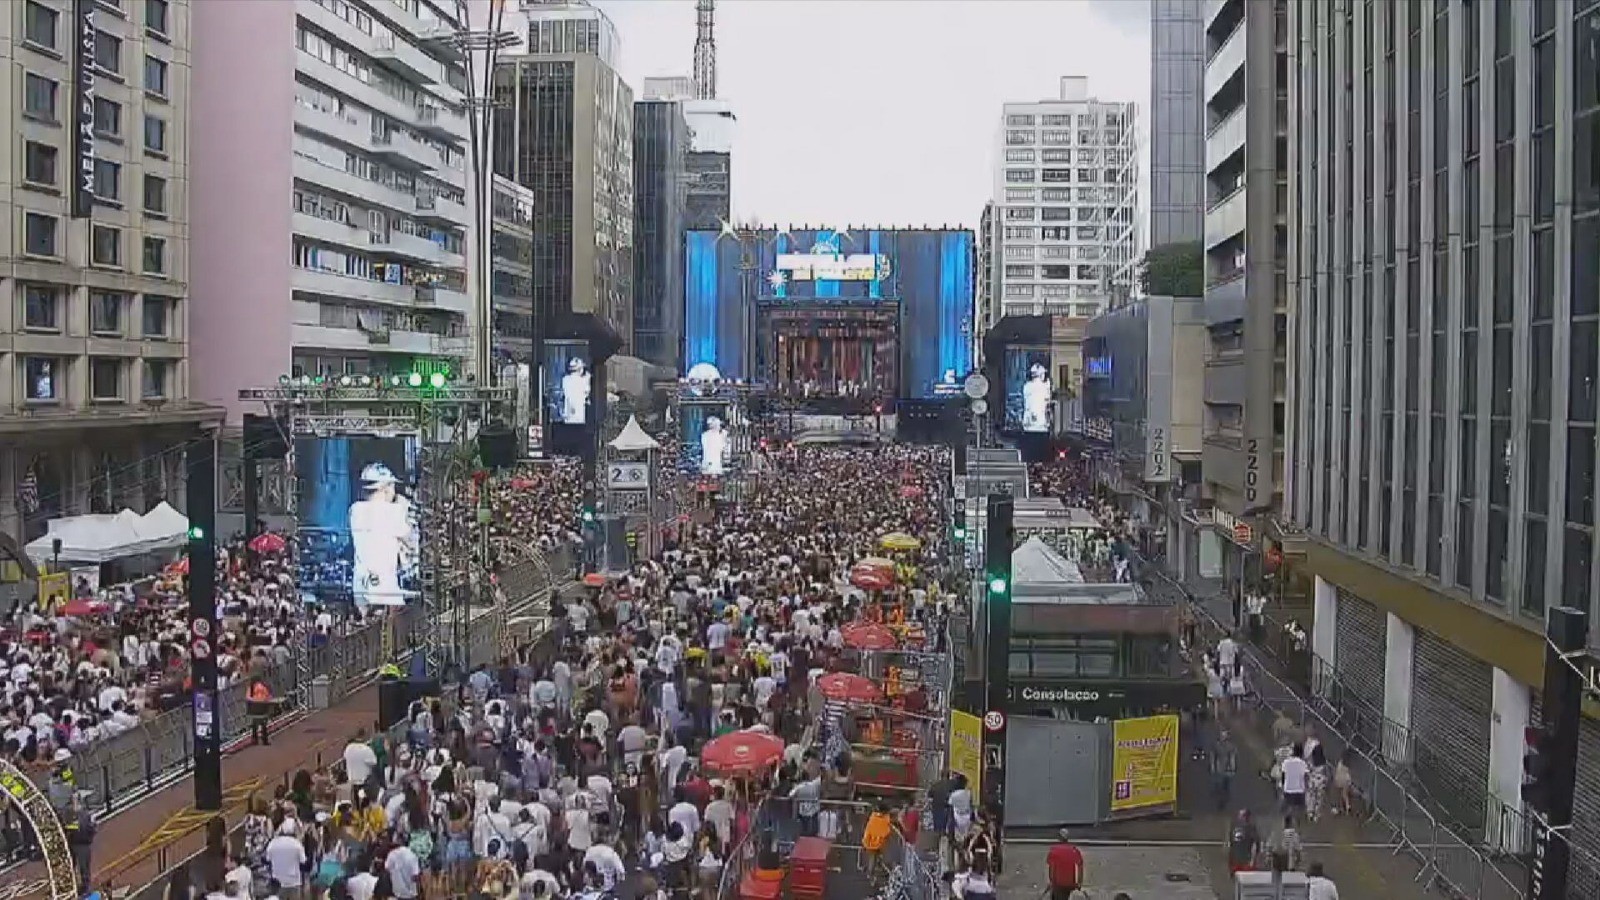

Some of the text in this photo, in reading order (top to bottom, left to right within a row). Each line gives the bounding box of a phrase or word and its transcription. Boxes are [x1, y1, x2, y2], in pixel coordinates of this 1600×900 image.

[83, 11, 95, 115] PAULISTA
[1153, 428, 1165, 476] 2202
[1246, 439, 1259, 502] 2200
[986, 714, 1001, 727] 50
